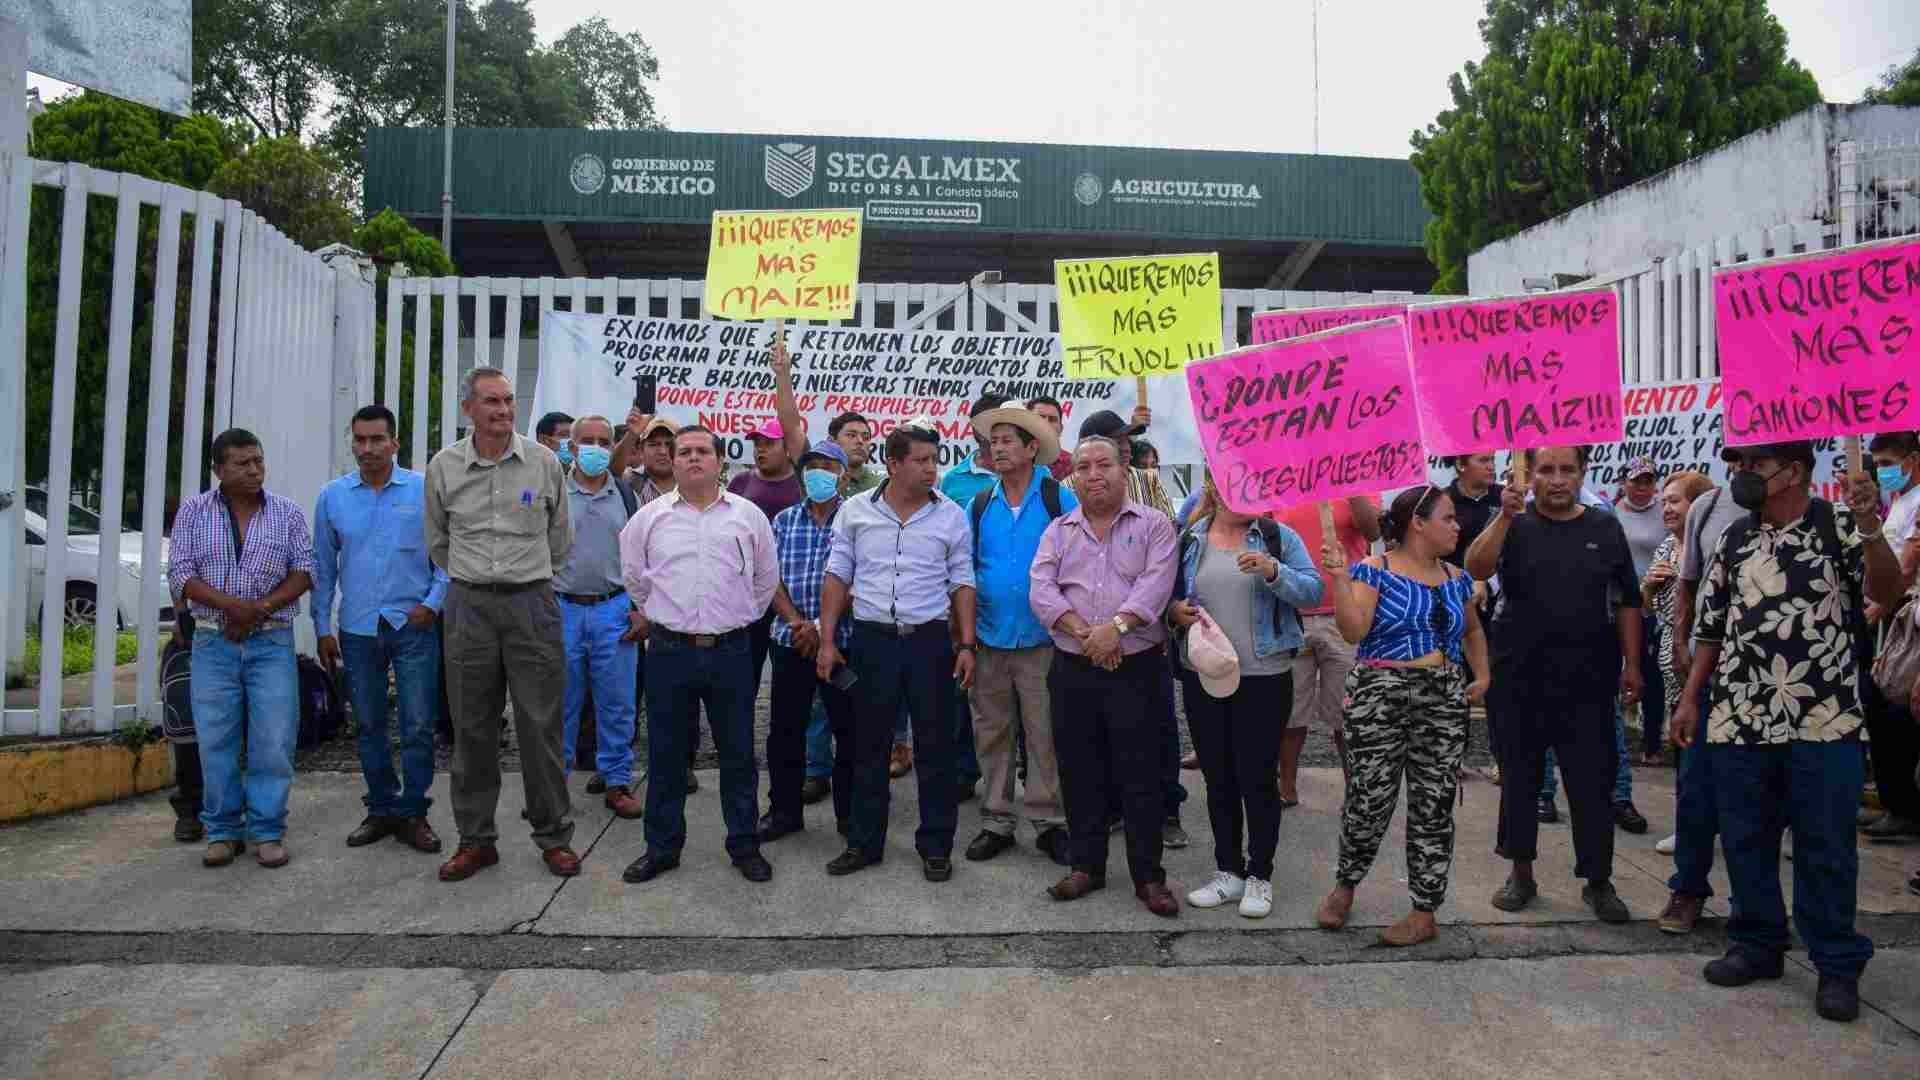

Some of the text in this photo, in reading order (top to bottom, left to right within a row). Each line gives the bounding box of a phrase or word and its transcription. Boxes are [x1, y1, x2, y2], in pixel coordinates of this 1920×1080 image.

[612, 158, 715, 171] GOBIERNO DE
[826, 152, 1021, 183] SEGALMEX
[610, 171, 715, 195] MÉXICO
[828, 182, 920, 196] DICONSA
[935, 184, 1018, 199] Canasta básica
[1109, 179, 1262, 199] AGRICULTURA
[871, 207, 977, 217] PRECIOS DE GARANTÍA
[718, 216, 855, 247] ¡¡¡QUEREMOS
[755, 245, 817, 280] MÁS
[1065, 260, 1214, 297] ¡¡¡QUEREMOS
[721, 276, 850, 317] MAÍZ!!!
[1113, 297, 1177, 336] MÁS
[603, 318, 710, 343] EXIGIMOS
[720, 326, 759, 347] QUE
[800, 330, 904, 352] RETOMEN
[910, 334, 944, 354] LOS
[951, 336, 1055, 357] OBJETIVOS
[1793, 306, 1912, 372] MÁS
[602, 340, 710, 365] PROGRAMA
[717, 348, 740, 366] DE
[743, 349, 802, 369] HAR
[809, 353, 877, 372] LLEGAR
[884, 355, 917, 373] LOS
[925, 356, 1030, 377] PRODUCTOS
[1483, 341, 1564, 387] MÁS
[615, 360, 626, 376] Y
[806, 373, 899, 394] NUESTRAS
[903, 377, 972, 398] TIENDAS
[981, 379, 1117, 400] COMUNITARIAS
[824, 394, 952, 417] PRESUPUESTOS
[1347, 385, 1403, 430] LOS
[1728, 380, 1911, 436] CAMIONES
[1692, 413, 1706, 434] Y
[1618, 439, 1685, 461] NUEVOS
[1693, 438, 1706, 458] Y
